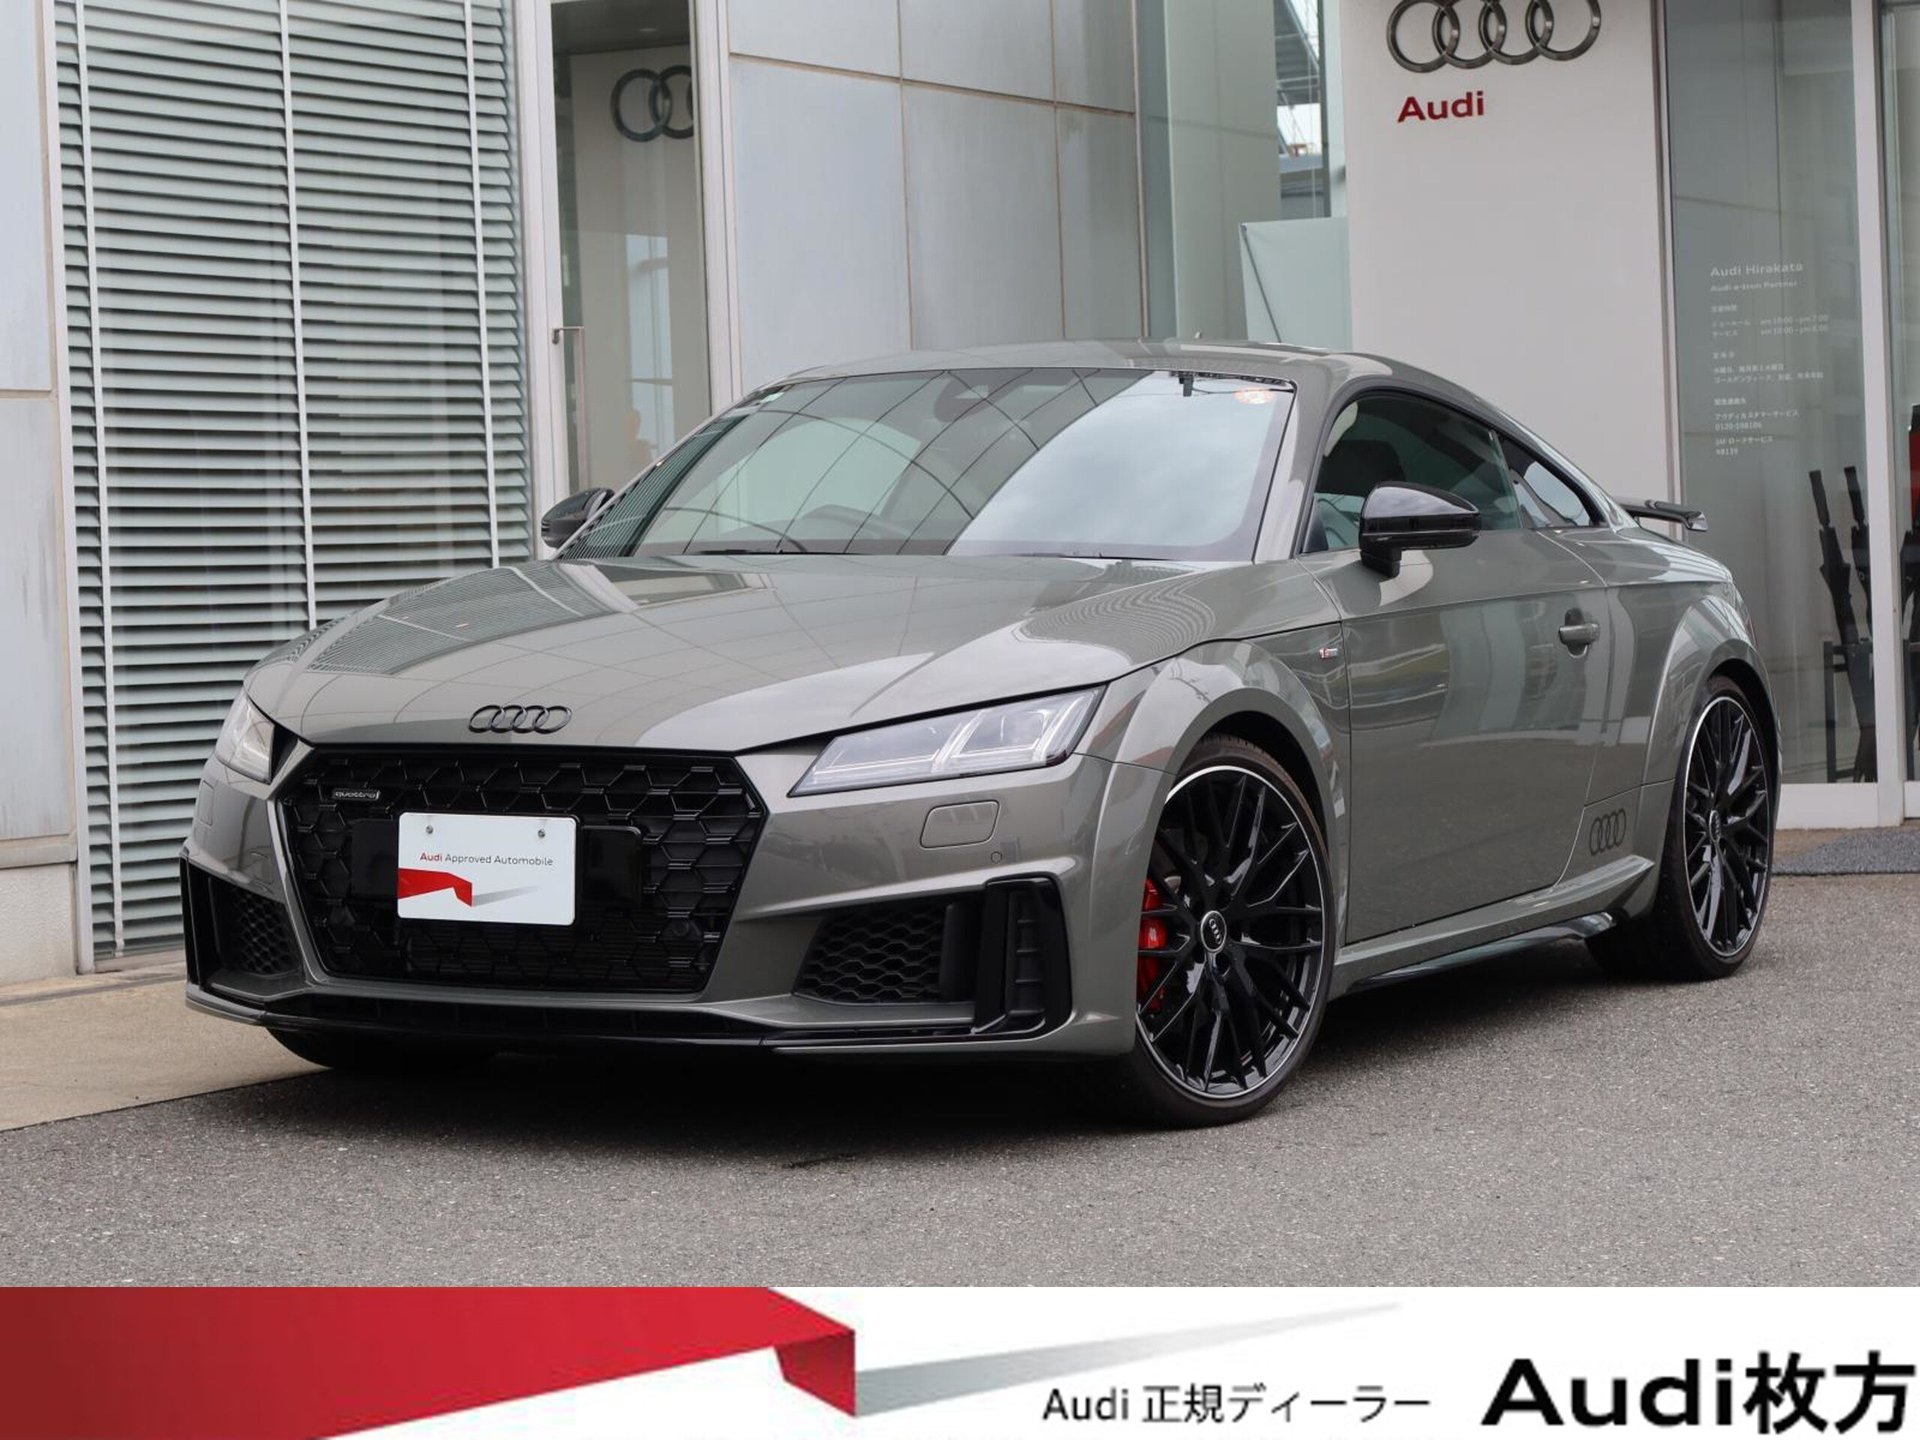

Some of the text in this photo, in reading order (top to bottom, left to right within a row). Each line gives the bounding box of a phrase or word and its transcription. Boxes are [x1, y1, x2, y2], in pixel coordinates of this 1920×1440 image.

[1398, 91, 1484, 123] Audi
[1710, 263, 1803, 277] Audi Hirakata
[420, 852, 554, 867] Audi Approved Automobile
